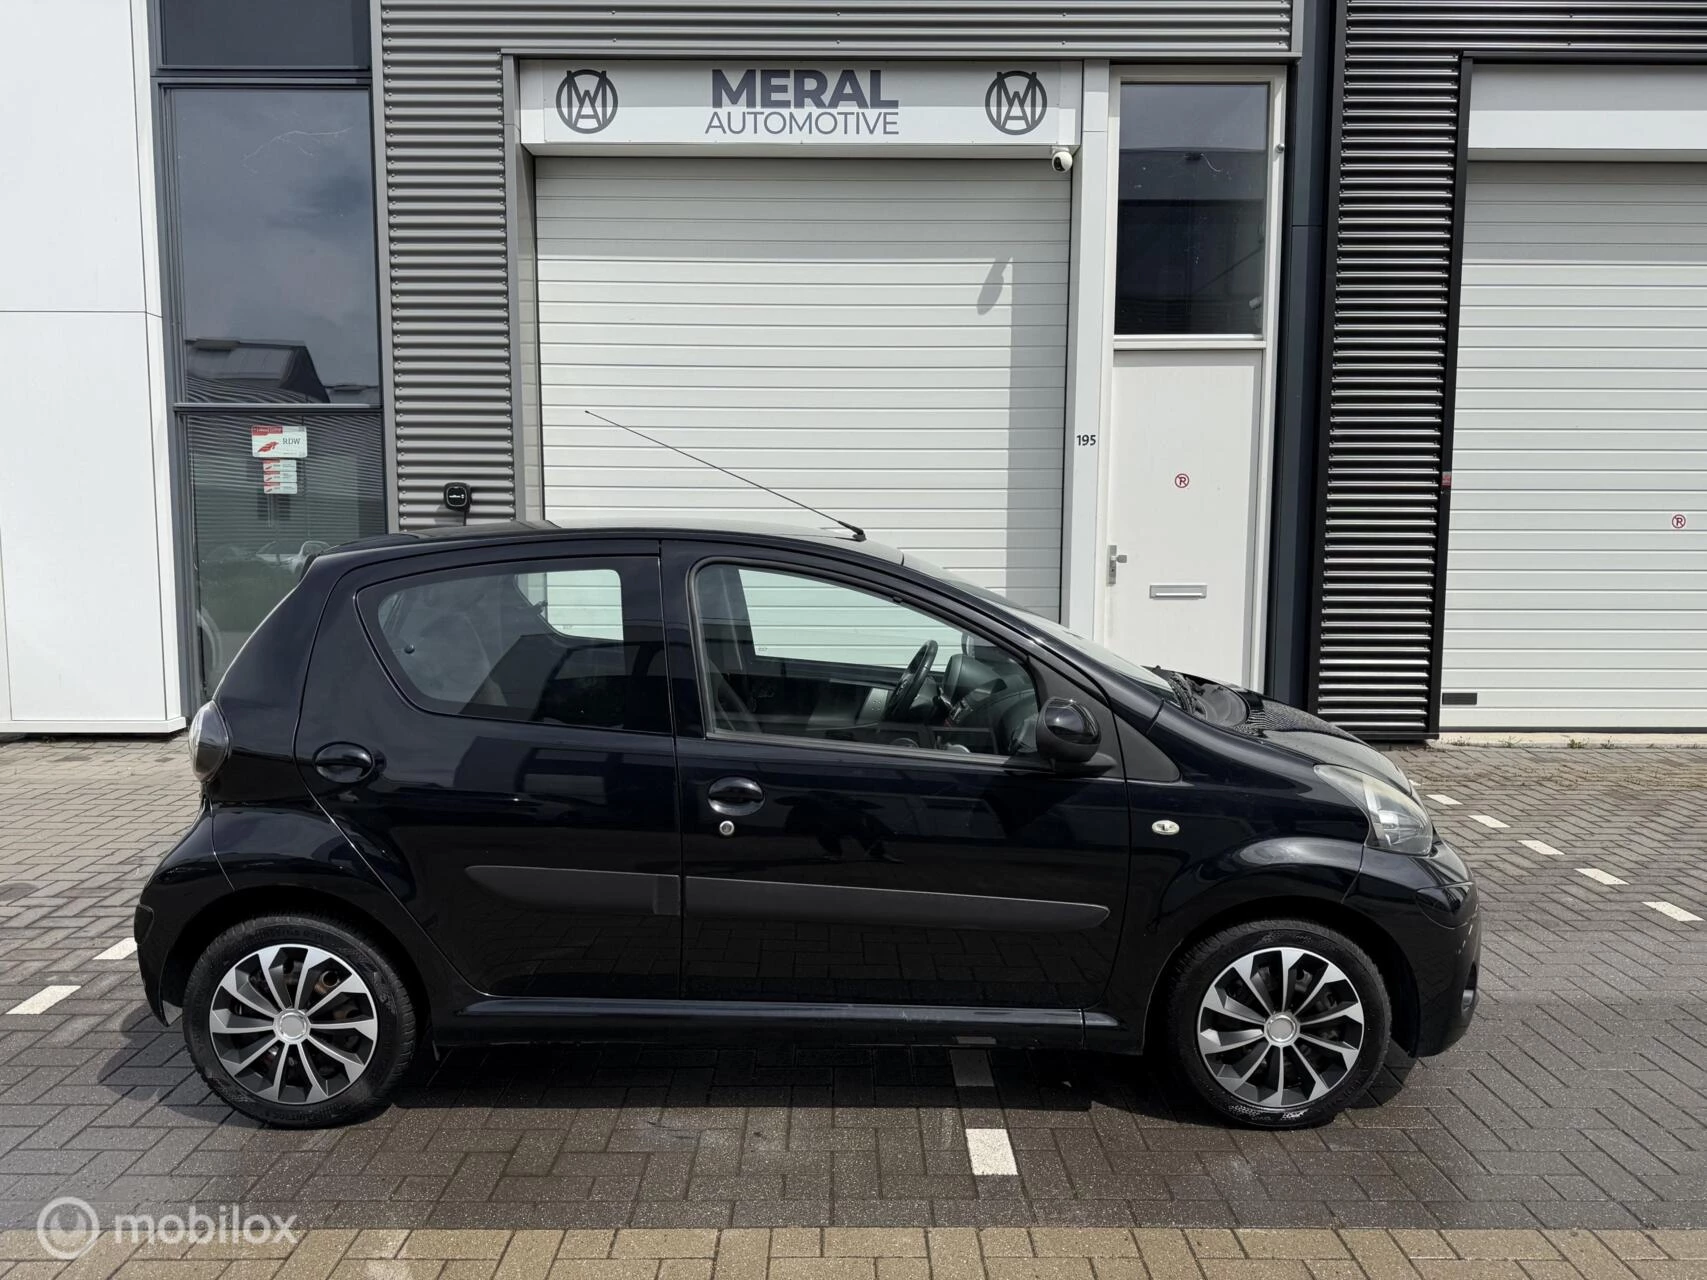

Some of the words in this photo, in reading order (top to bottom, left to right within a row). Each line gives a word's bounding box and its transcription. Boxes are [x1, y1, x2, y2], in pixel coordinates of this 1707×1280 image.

[711, 69, 899, 109] MERAL
[704, 111, 899, 135] AUTOMOTIVE
[1076, 434, 1097, 446] 195
